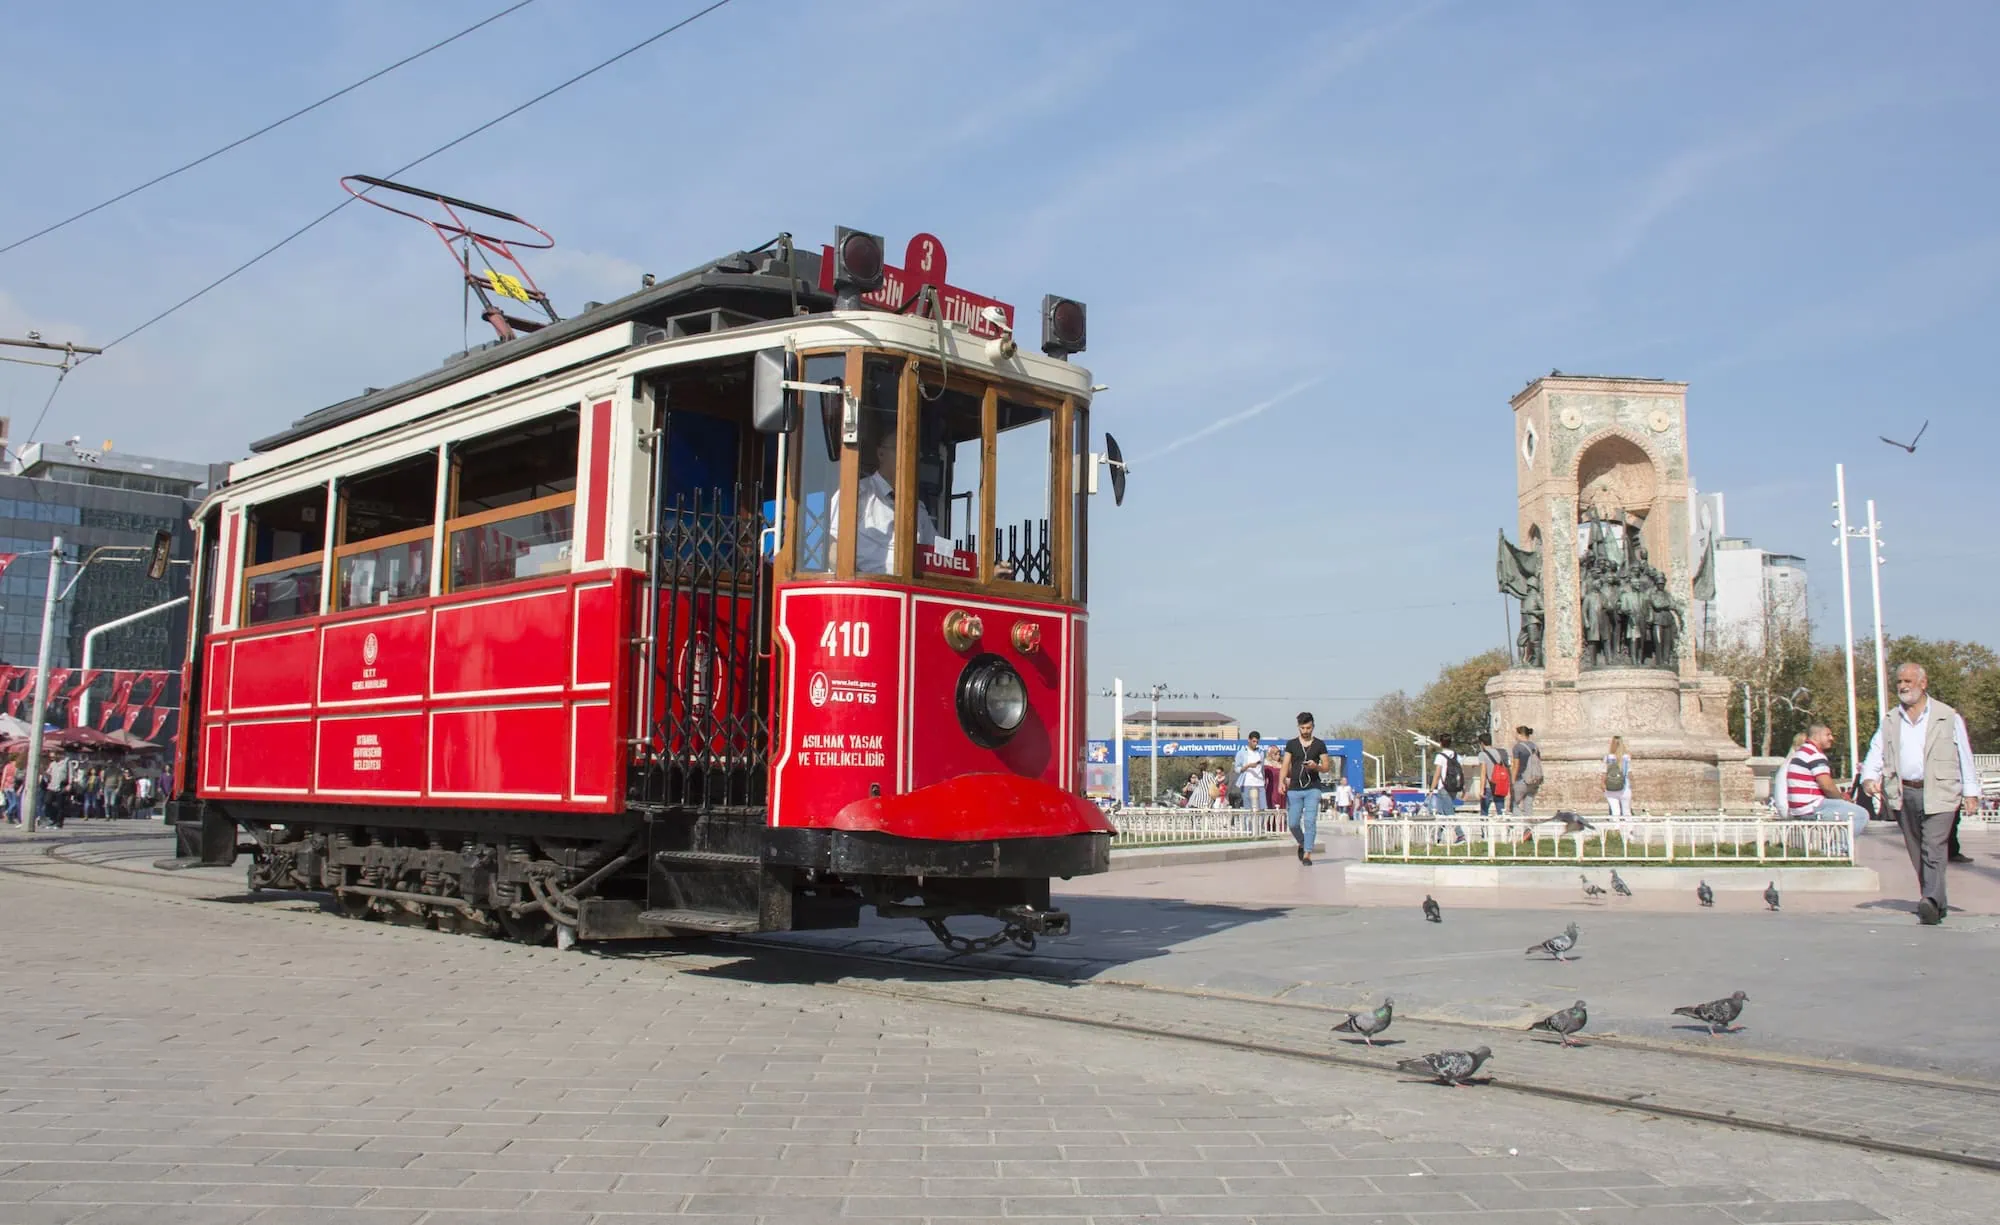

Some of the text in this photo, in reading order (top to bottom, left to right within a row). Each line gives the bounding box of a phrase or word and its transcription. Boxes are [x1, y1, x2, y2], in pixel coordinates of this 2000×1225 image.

[921, 240, 935, 272] 3
[944, 294, 996, 337] TÜNEL
[820, 621, 870, 658] 410
[830, 691, 877, 704] ALO 153
[802, 734, 883, 750] ASILMAK YASAK
[798, 750, 885, 767] VE TEHLİKELİDİR
